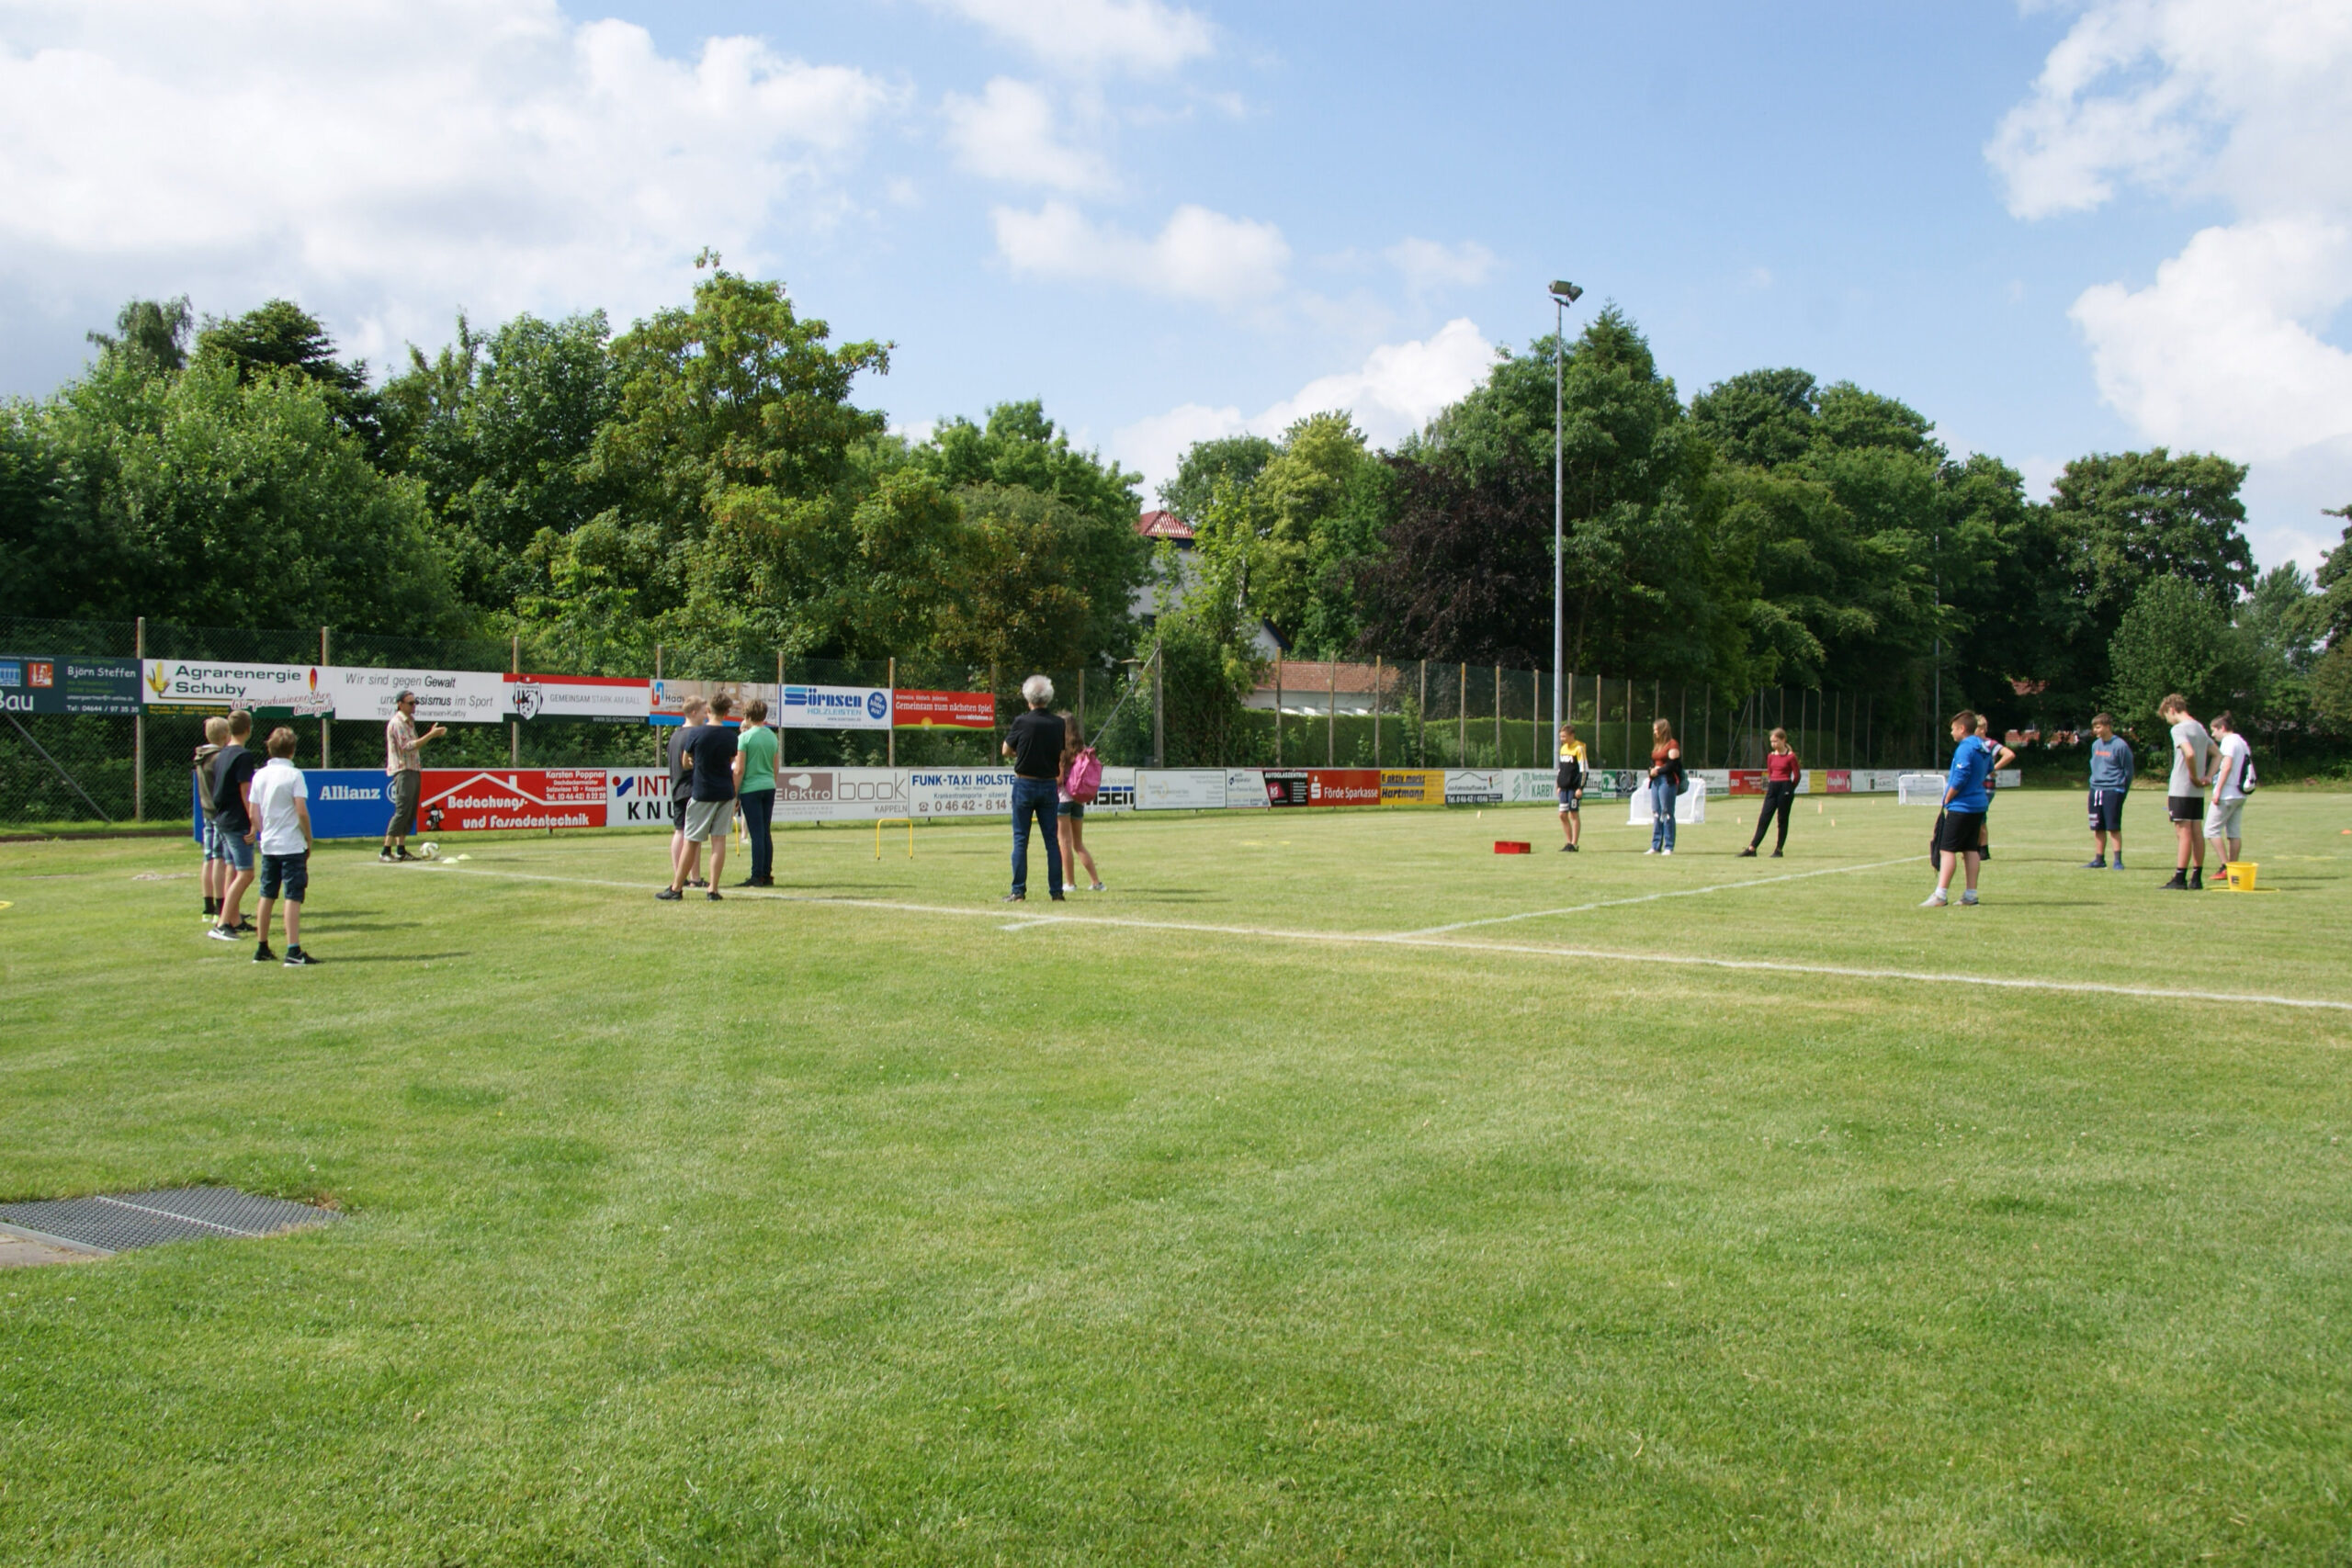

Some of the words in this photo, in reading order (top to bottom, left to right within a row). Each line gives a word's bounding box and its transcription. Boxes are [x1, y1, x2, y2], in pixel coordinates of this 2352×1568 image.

[67, 666, 95, 678] Björn
[97, 667, 137, 678] Steffen
[175, 665, 301, 682] Agrarenergie
[345, 673, 364, 684] Wir
[368, 674, 390, 685] sind
[392, 676, 422, 688] gegen
[424, 675, 457, 688] Gewalt
[175, 682, 247, 697] Schuby
[455, 695, 466, 705] im
[469, 695, 493, 709] Sport
[550, 694, 591, 703] GEMEINSAM
[592, 695, 611, 704] STARK
[378, 708, 392, 716] TSV
[807, 707, 862, 716] HOLZLEISTEN
[896, 702, 933, 711] Gemeinsam
[934, 703, 948, 711] zum
[949, 703, 977, 712] nächsten
[546, 771, 573, 779] Karsten
[911, 774, 972, 786] FUNK-TAXI
[976, 774, 1015, 785] HOLSTE
[1387, 773, 1404, 783] aktiv
[1407, 774, 1426, 783] markt
[638, 775, 670, 797] INT
[838, 772, 907, 800] book
[1532, 784, 1555, 797] KARBY
[319, 785, 381, 800] Allianz
[775, 788, 831, 800] Elektro
[1324, 787, 1344, 798] Förde
[1345, 787, 1378, 800] Sparkasse
[1381, 789, 1424, 798] Hartmann
[447, 795, 528, 812] Bedachungs-
[875, 805, 908, 813] KAPPELN
[945, 801, 958, 811] 46
[962, 800, 975, 811] 42
[462, 816, 486, 829] und
